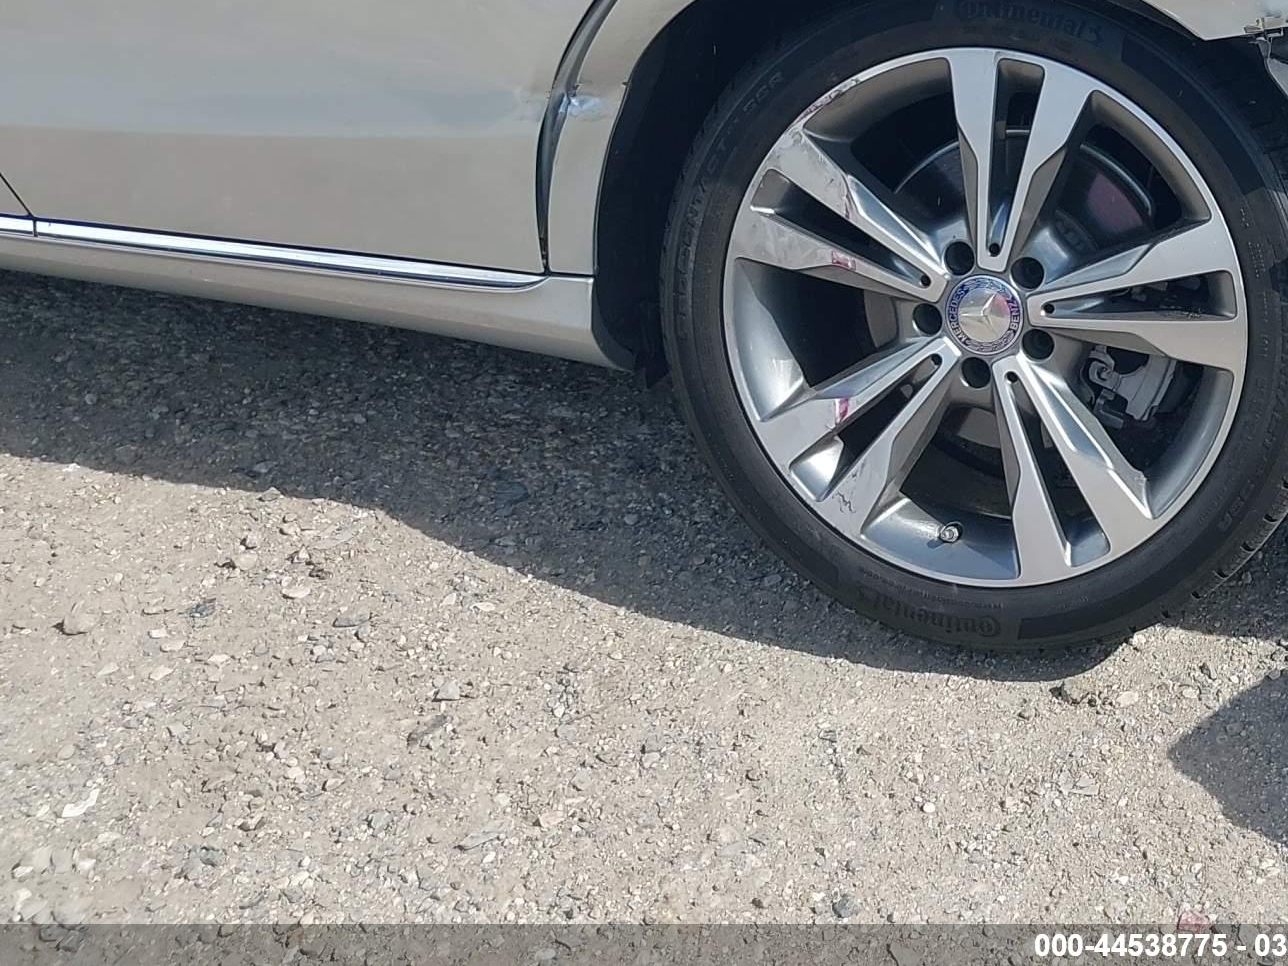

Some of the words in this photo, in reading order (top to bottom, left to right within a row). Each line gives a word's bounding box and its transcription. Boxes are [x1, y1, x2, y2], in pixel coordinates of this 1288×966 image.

[949, 288, 968, 343] MERCEDES
[1009, 301, 1021, 331] BENZ
[873, 592, 1002, 638] Continental
